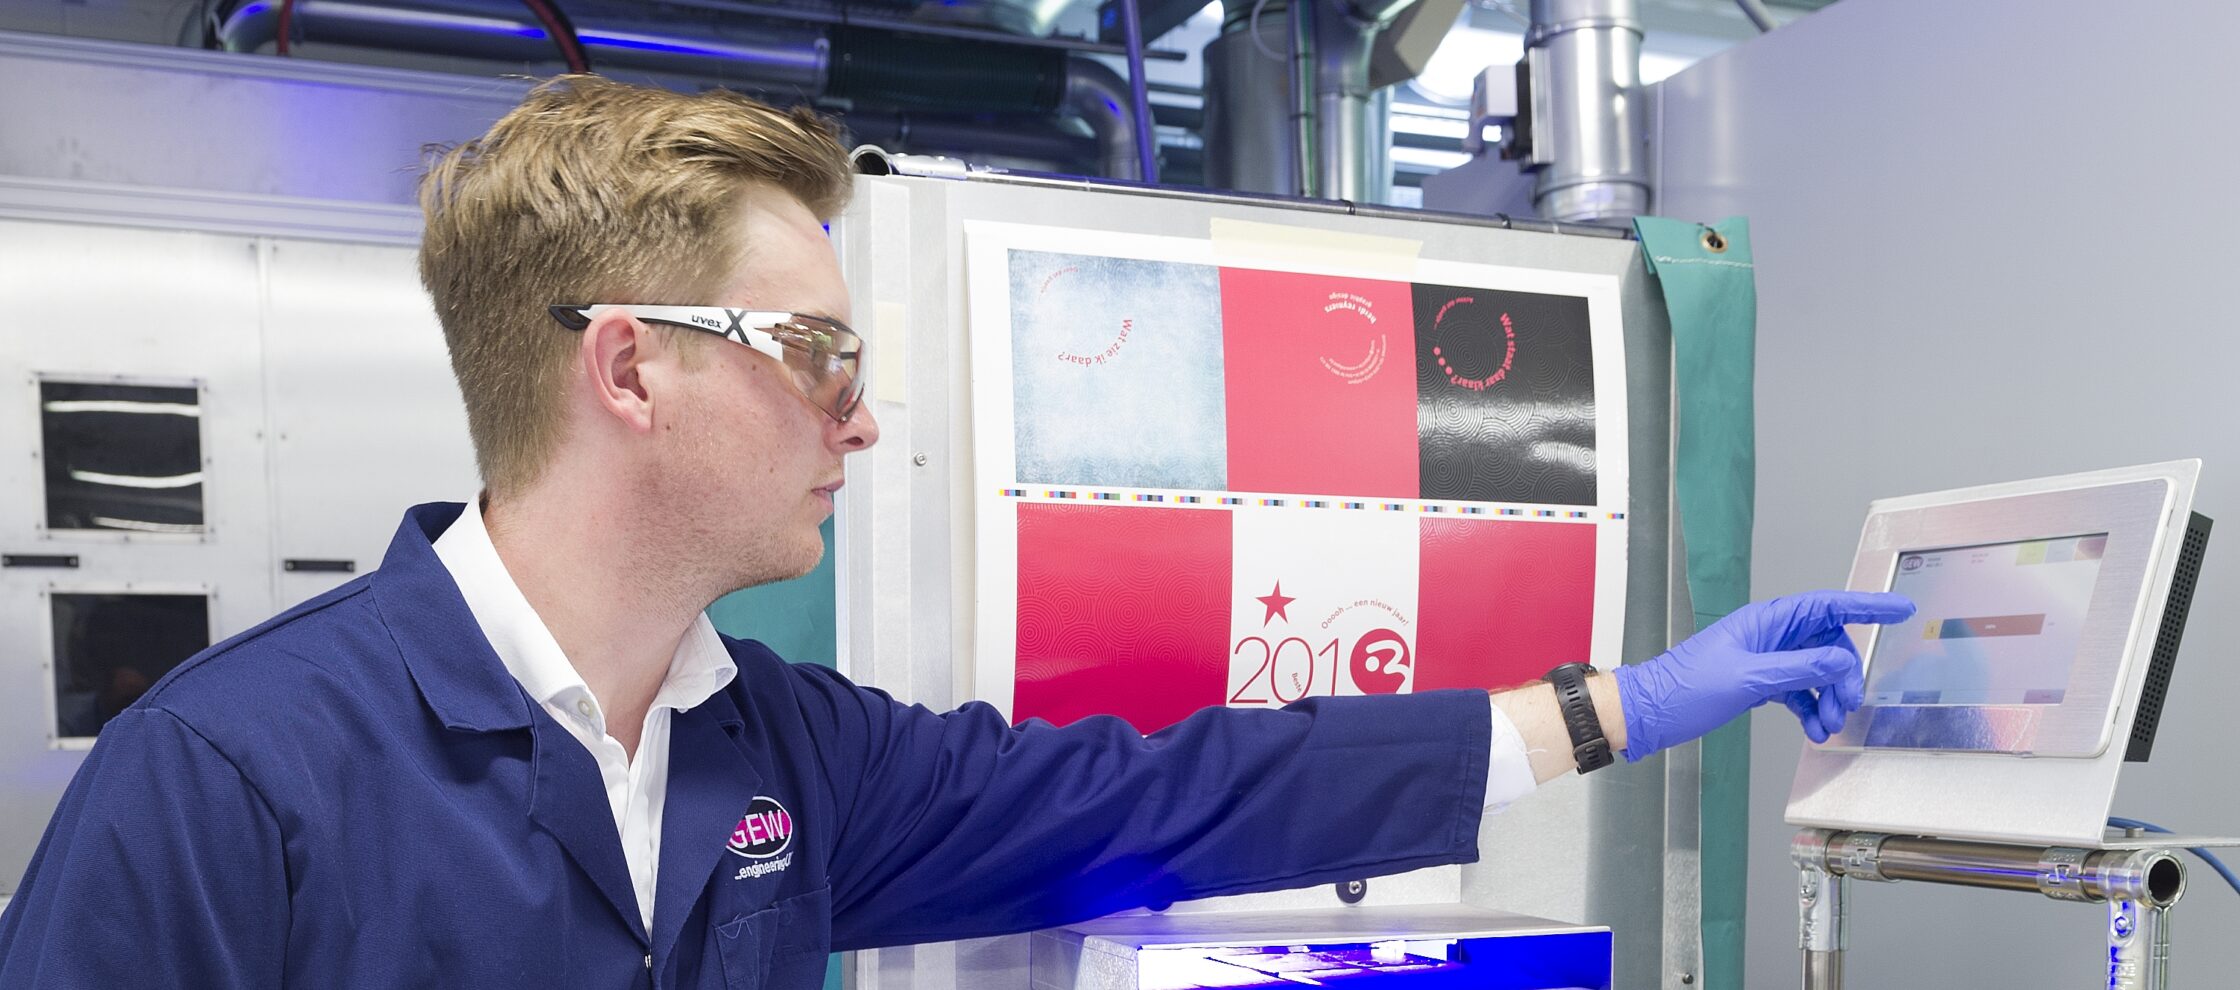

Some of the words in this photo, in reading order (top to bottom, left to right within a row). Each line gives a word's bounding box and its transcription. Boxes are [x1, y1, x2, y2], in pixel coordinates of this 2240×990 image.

[691, 314, 722, 329] uvex
[1118, 319, 1132, 343] Wat
[1499, 312, 1516, 339] Wat
[1094, 353, 1107, 365] ik
[1106, 342, 1120, 356] zie
[1502, 340, 1517, 371] staat
[1058, 352, 1092, 367] daar?
[1450, 374, 1485, 392] klaar?
[1485, 368, 1506, 388] daar
[1321, 605, 1345, 630] Ooooh
[1353, 599, 1369, 608] een
[1370, 599, 1392, 612] nieuw
[1392, 607, 1409, 627] jaar!
[1291, 671, 1303, 694] Beste
